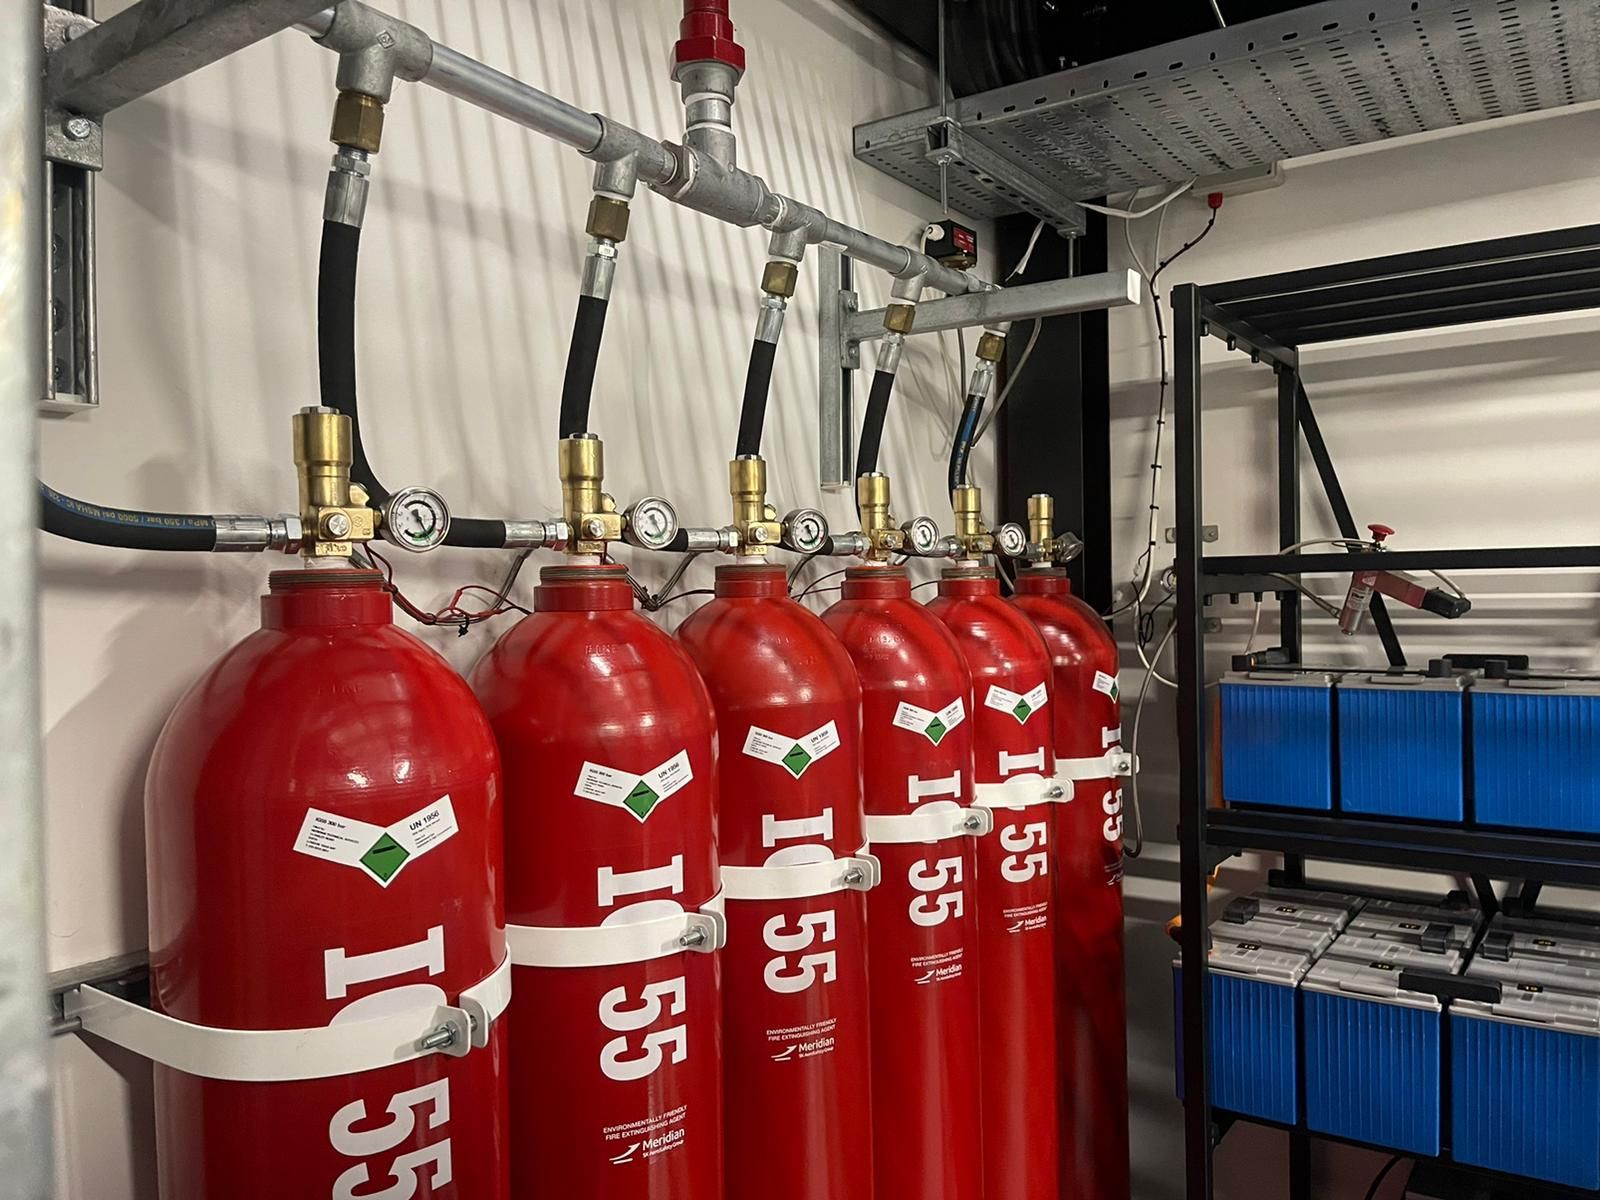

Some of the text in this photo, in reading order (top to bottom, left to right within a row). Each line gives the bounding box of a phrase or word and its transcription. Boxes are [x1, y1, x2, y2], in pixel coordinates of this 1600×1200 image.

[409, 820, 422, 831] UN
[422, 809, 440, 824] 1956
[1000, 822, 1048, 883] 55
[908, 856, 963, 927] 55
[763, 909, 836, 994] 55
[936, 963, 962, 977] Meridian
[599, 976, 687, 1081] 55
[766, 1023, 815, 1036] ENVIRONMENTALLY
[799, 1037, 835, 1053] Meridian
[603, 1104, 688, 1134] ENVIRONMENTALLY FRIENDLY
[605, 1112, 687, 1141] FIRE EXTINGUISHING AGENT
[329, 1077, 453, 1200] 55
[642, 1128, 685, 1151] Meridian
